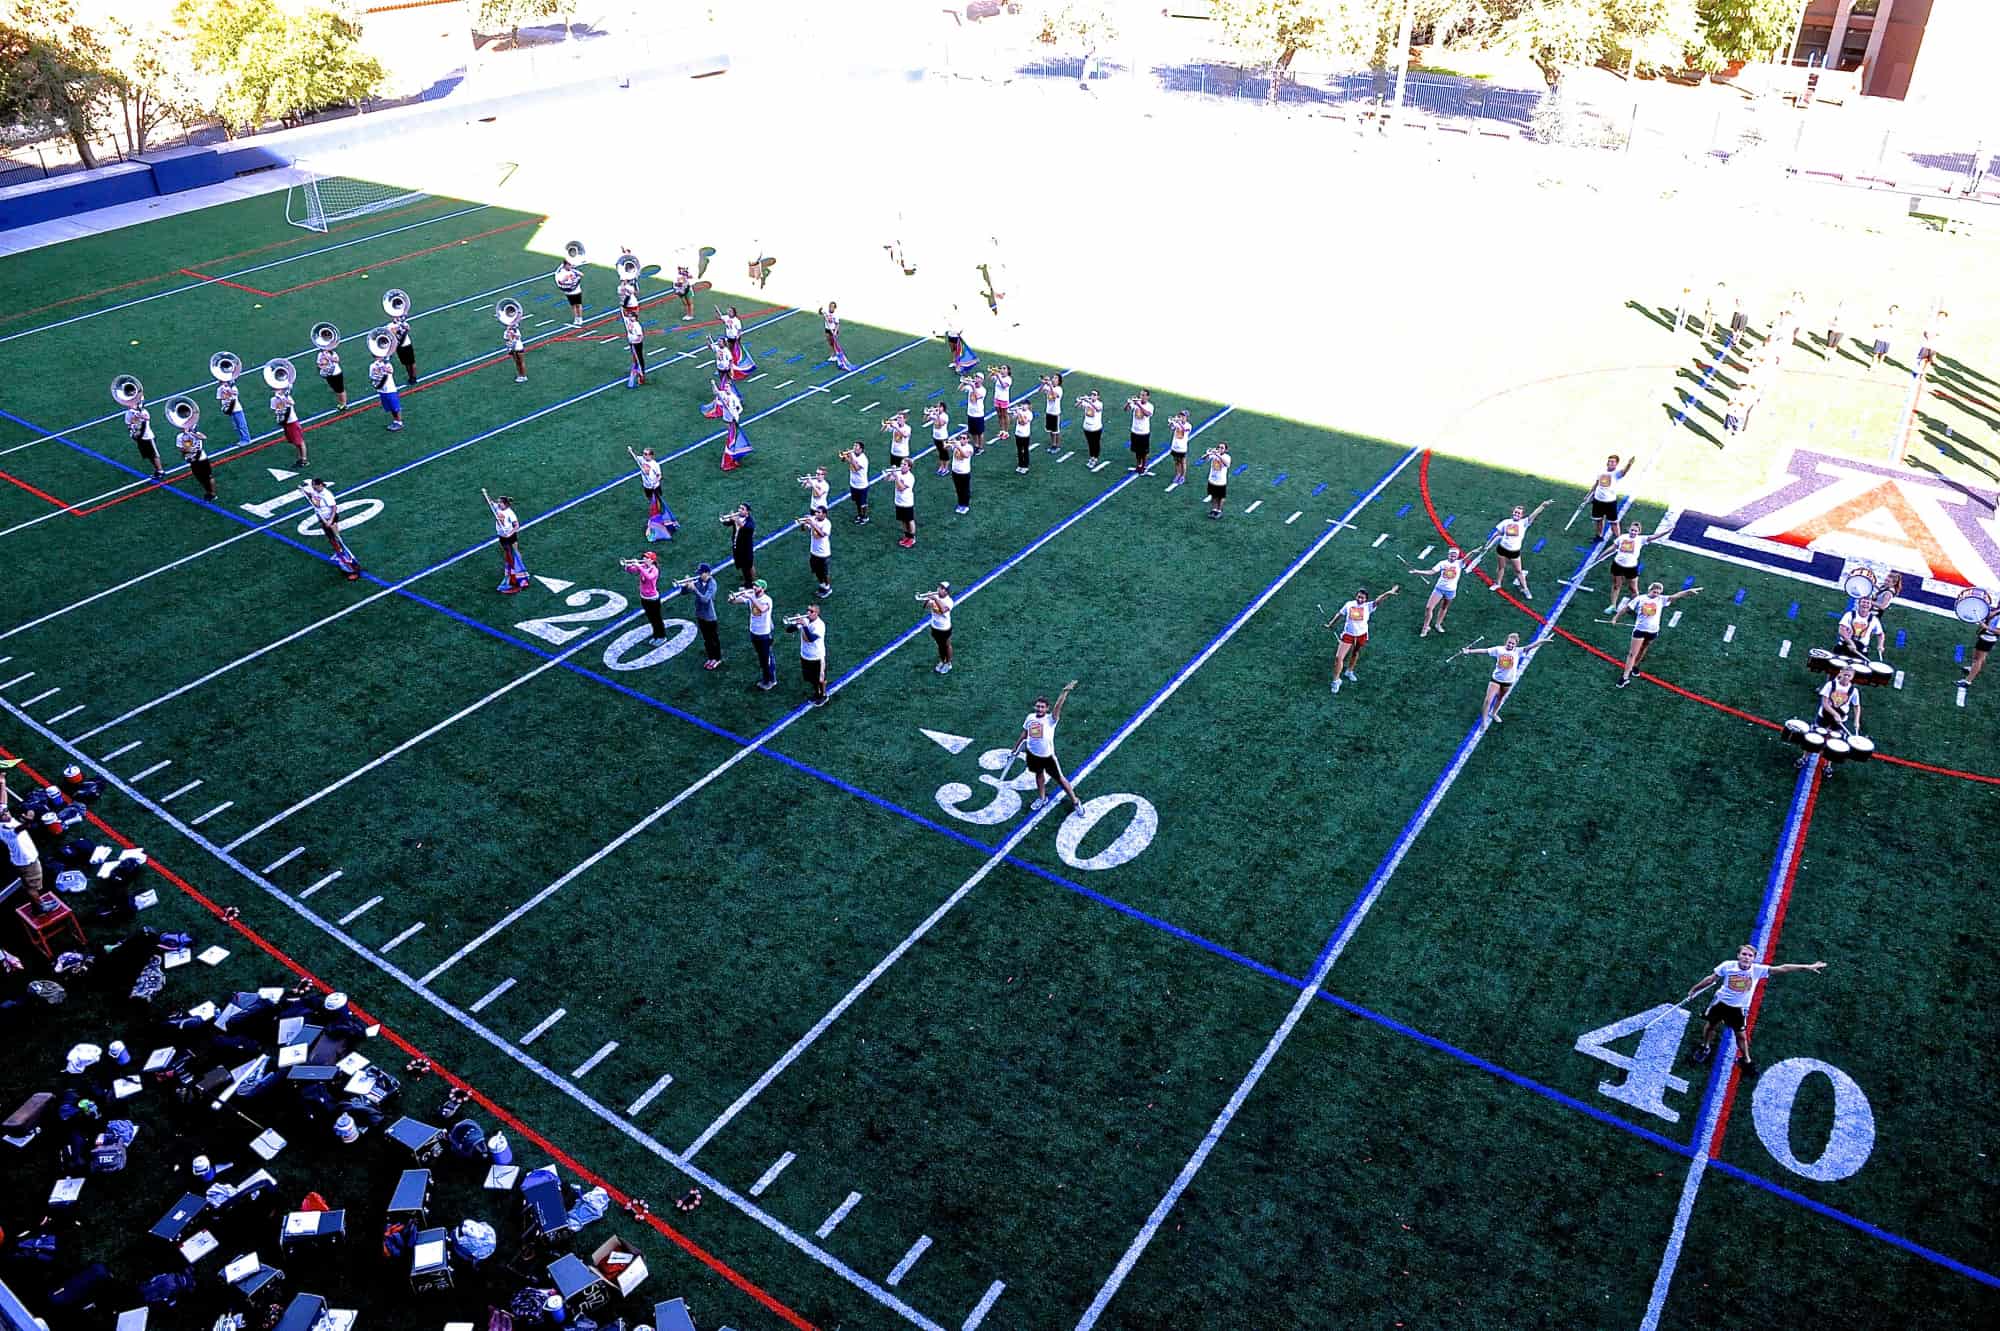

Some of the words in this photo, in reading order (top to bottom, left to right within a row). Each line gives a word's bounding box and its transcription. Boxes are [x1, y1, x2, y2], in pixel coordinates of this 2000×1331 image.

[513, 588, 698, 671] 20
[934, 748, 1159, 871] 30
[1574, 1003, 1876, 1182] 40
